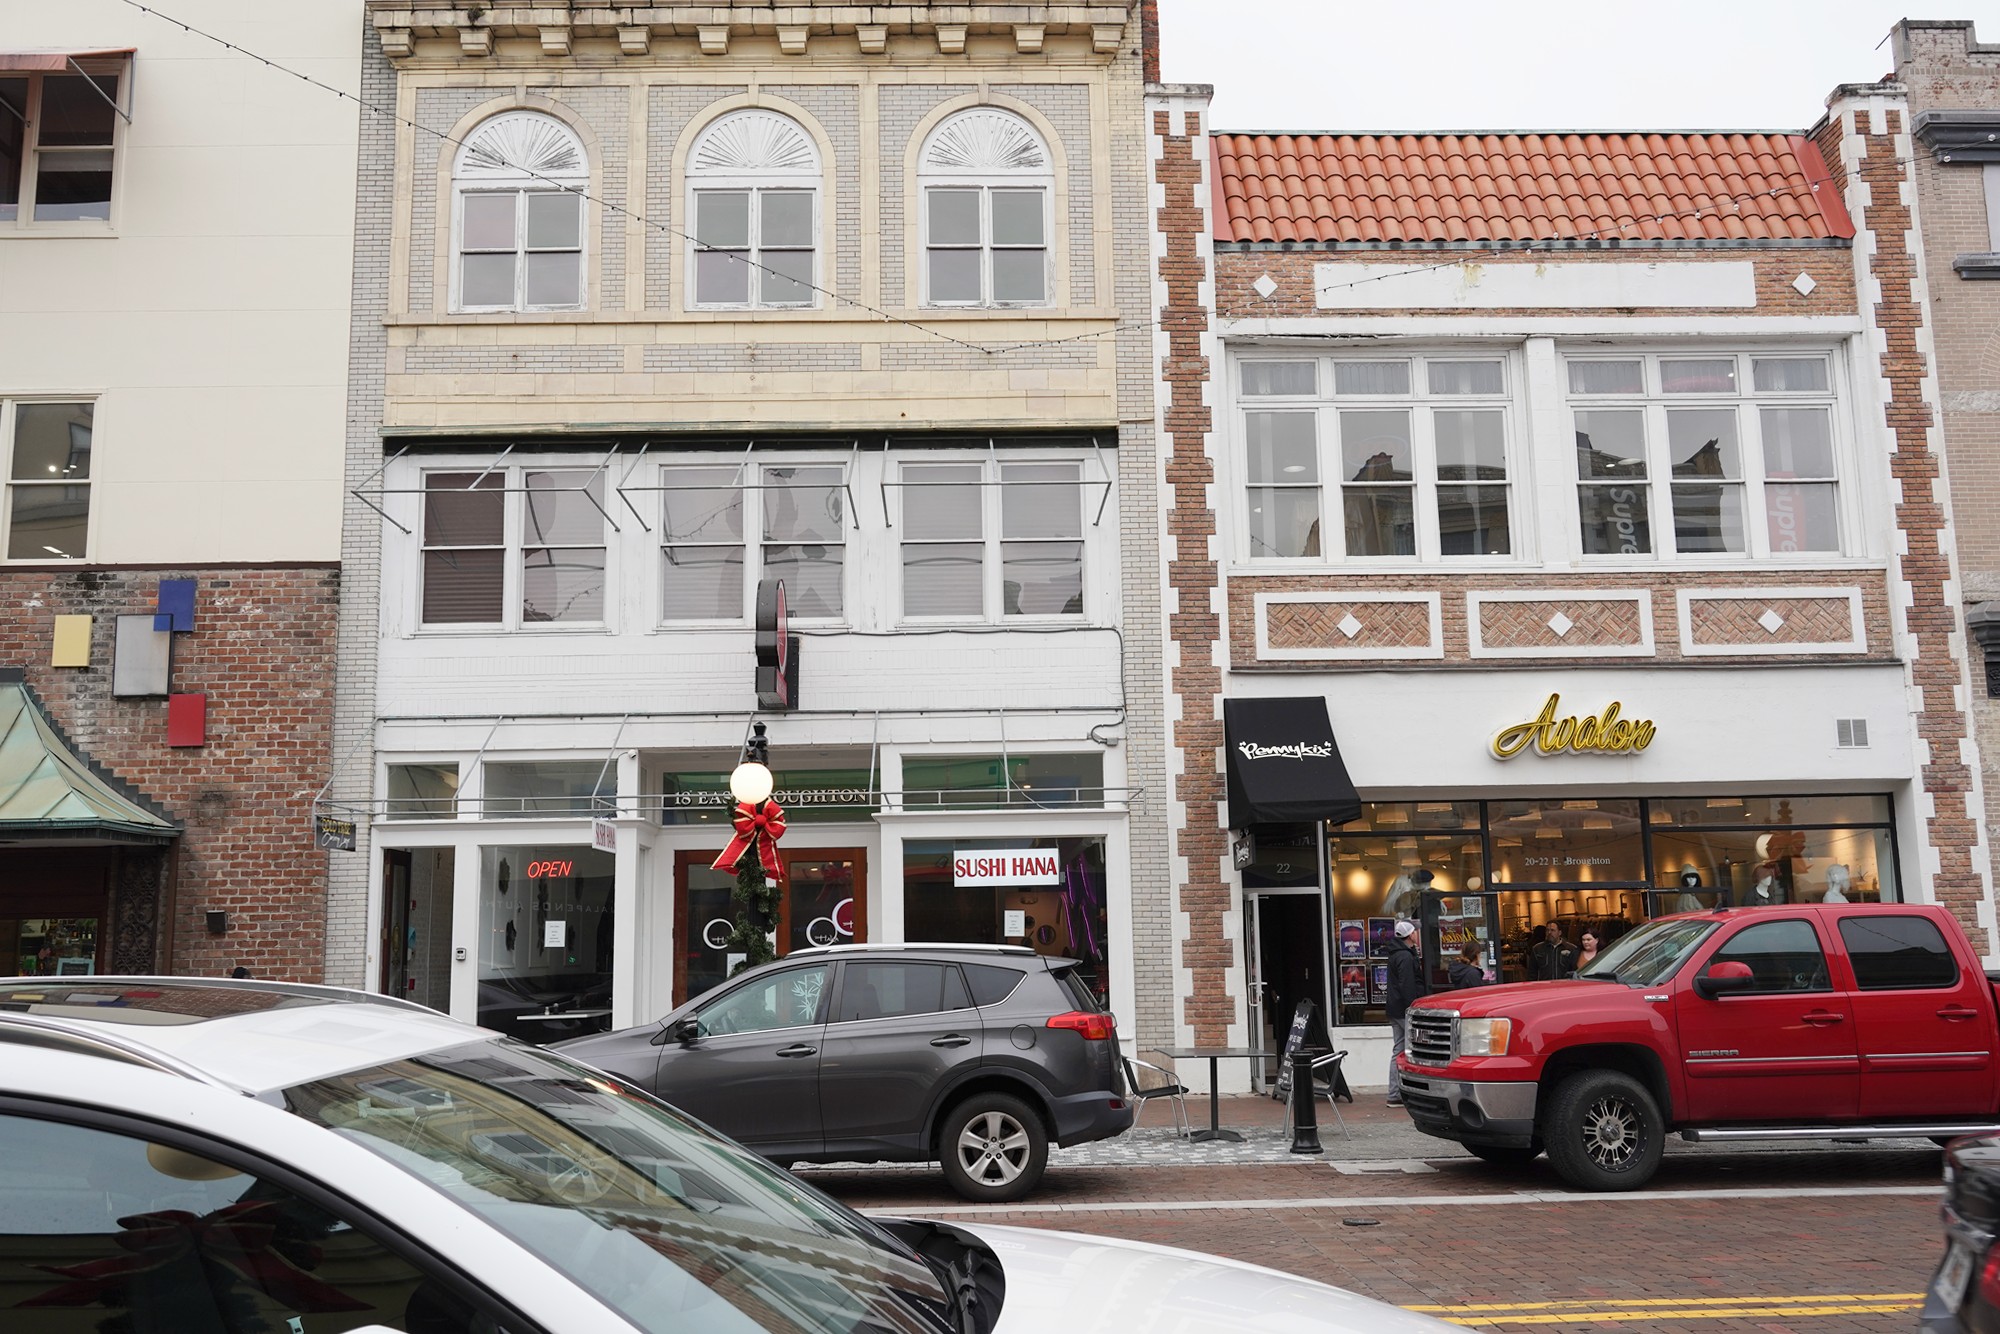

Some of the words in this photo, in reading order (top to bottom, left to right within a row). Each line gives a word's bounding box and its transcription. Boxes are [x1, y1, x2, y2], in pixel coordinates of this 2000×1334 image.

[1491, 692, 1657, 758] Avalon
[674, 791, 692, 805] 18
[697, 791, 740, 805] EAS
[772, 788, 867, 804] OUGHTON
[527, 860, 573, 878] OPEN
[955, 858, 1006, 878] SUSHI
[1012, 856, 1058, 876] HANA
[1276, 863, 1291, 874] 22
[1525, 857, 1549, 866] 20-22
[1565, 856, 1611, 867] Broughton
[1689, 1049, 1740, 1057] SIERRA
